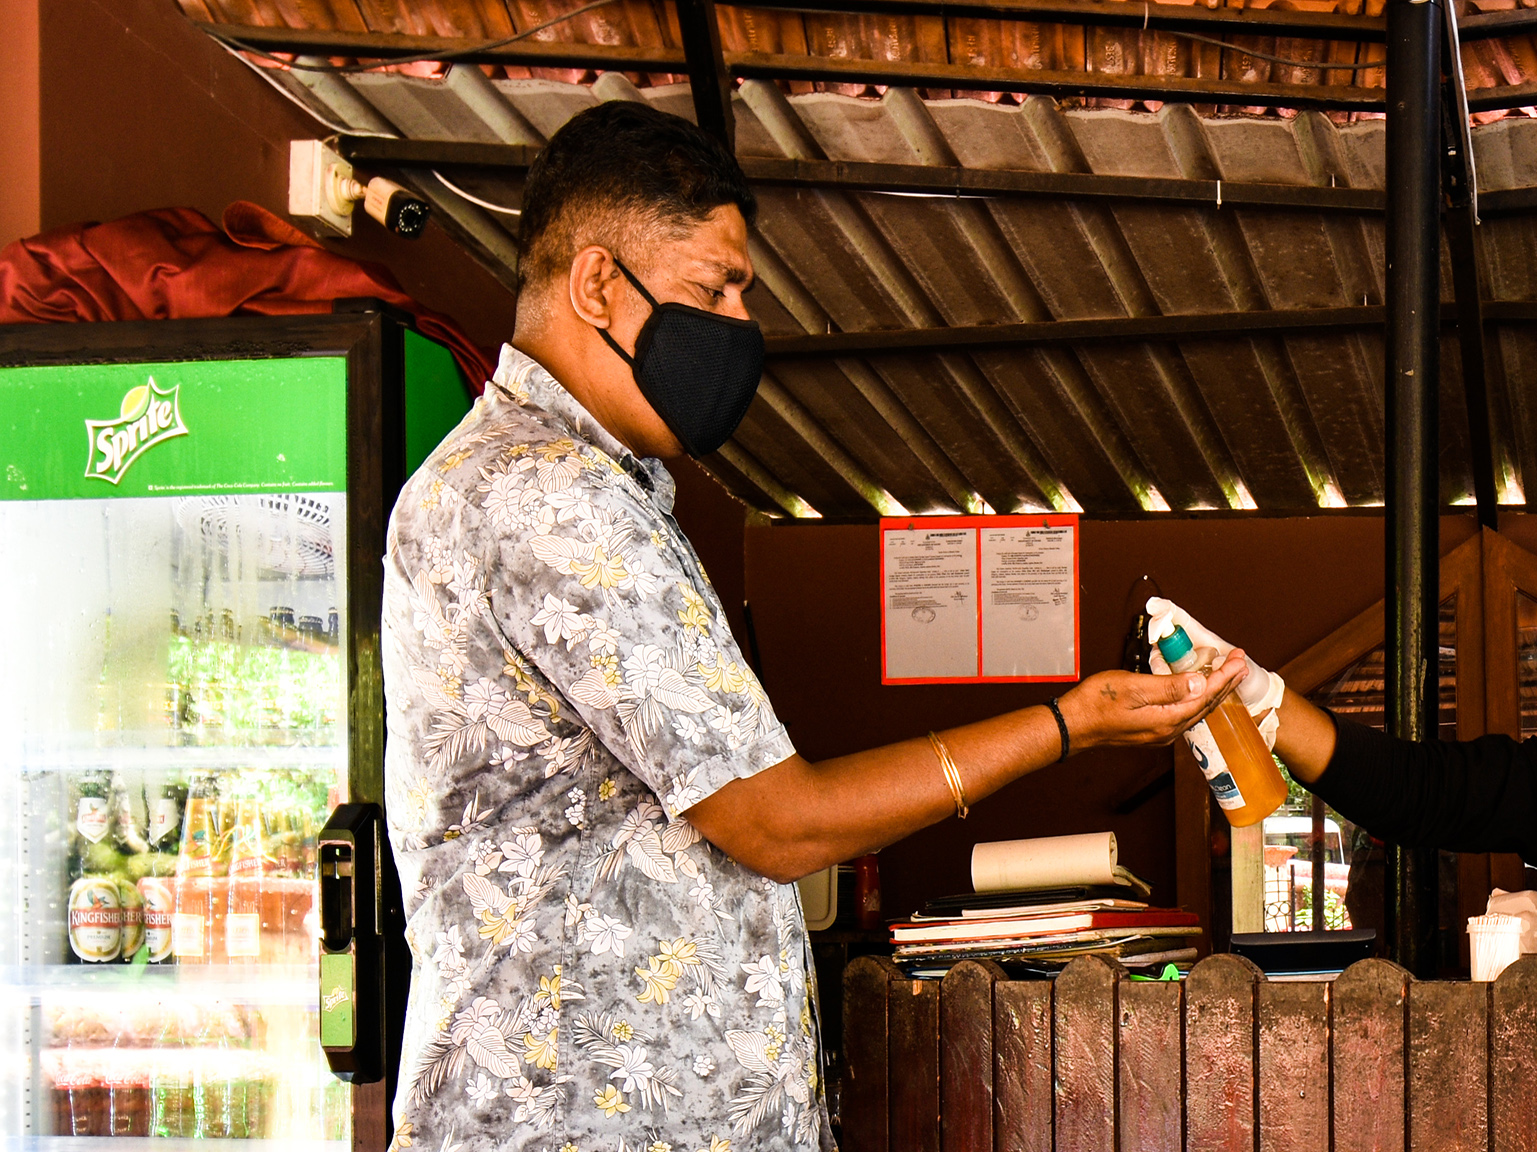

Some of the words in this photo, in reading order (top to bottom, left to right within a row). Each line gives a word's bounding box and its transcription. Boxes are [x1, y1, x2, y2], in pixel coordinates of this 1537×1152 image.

[96, 393, 173, 473] Sprite
[72, 910, 118, 925] KINGFISHE
[144, 913, 172, 925] FISHER
[325, 990, 345, 1009] Sprite
